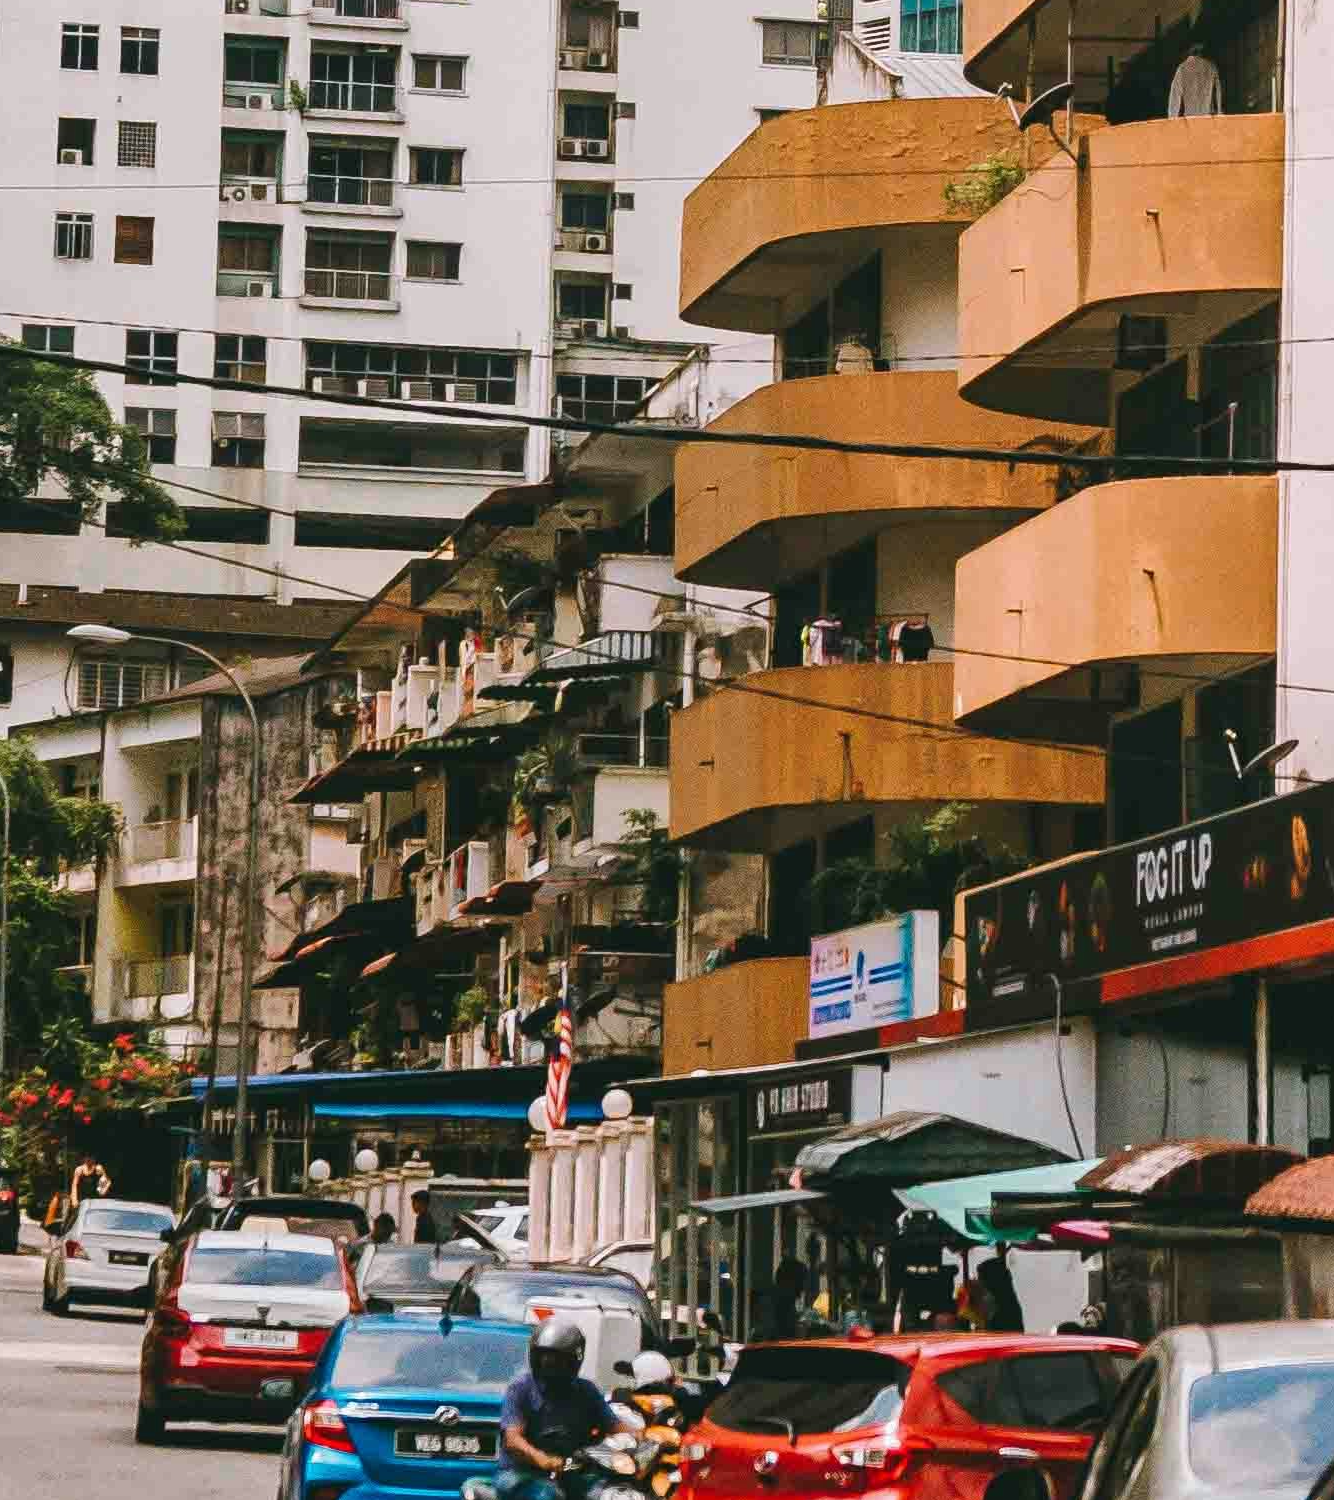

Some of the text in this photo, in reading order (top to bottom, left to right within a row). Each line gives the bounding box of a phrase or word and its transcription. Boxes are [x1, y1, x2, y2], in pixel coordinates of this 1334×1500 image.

[1135, 833, 1212, 907] FOG IT UP
